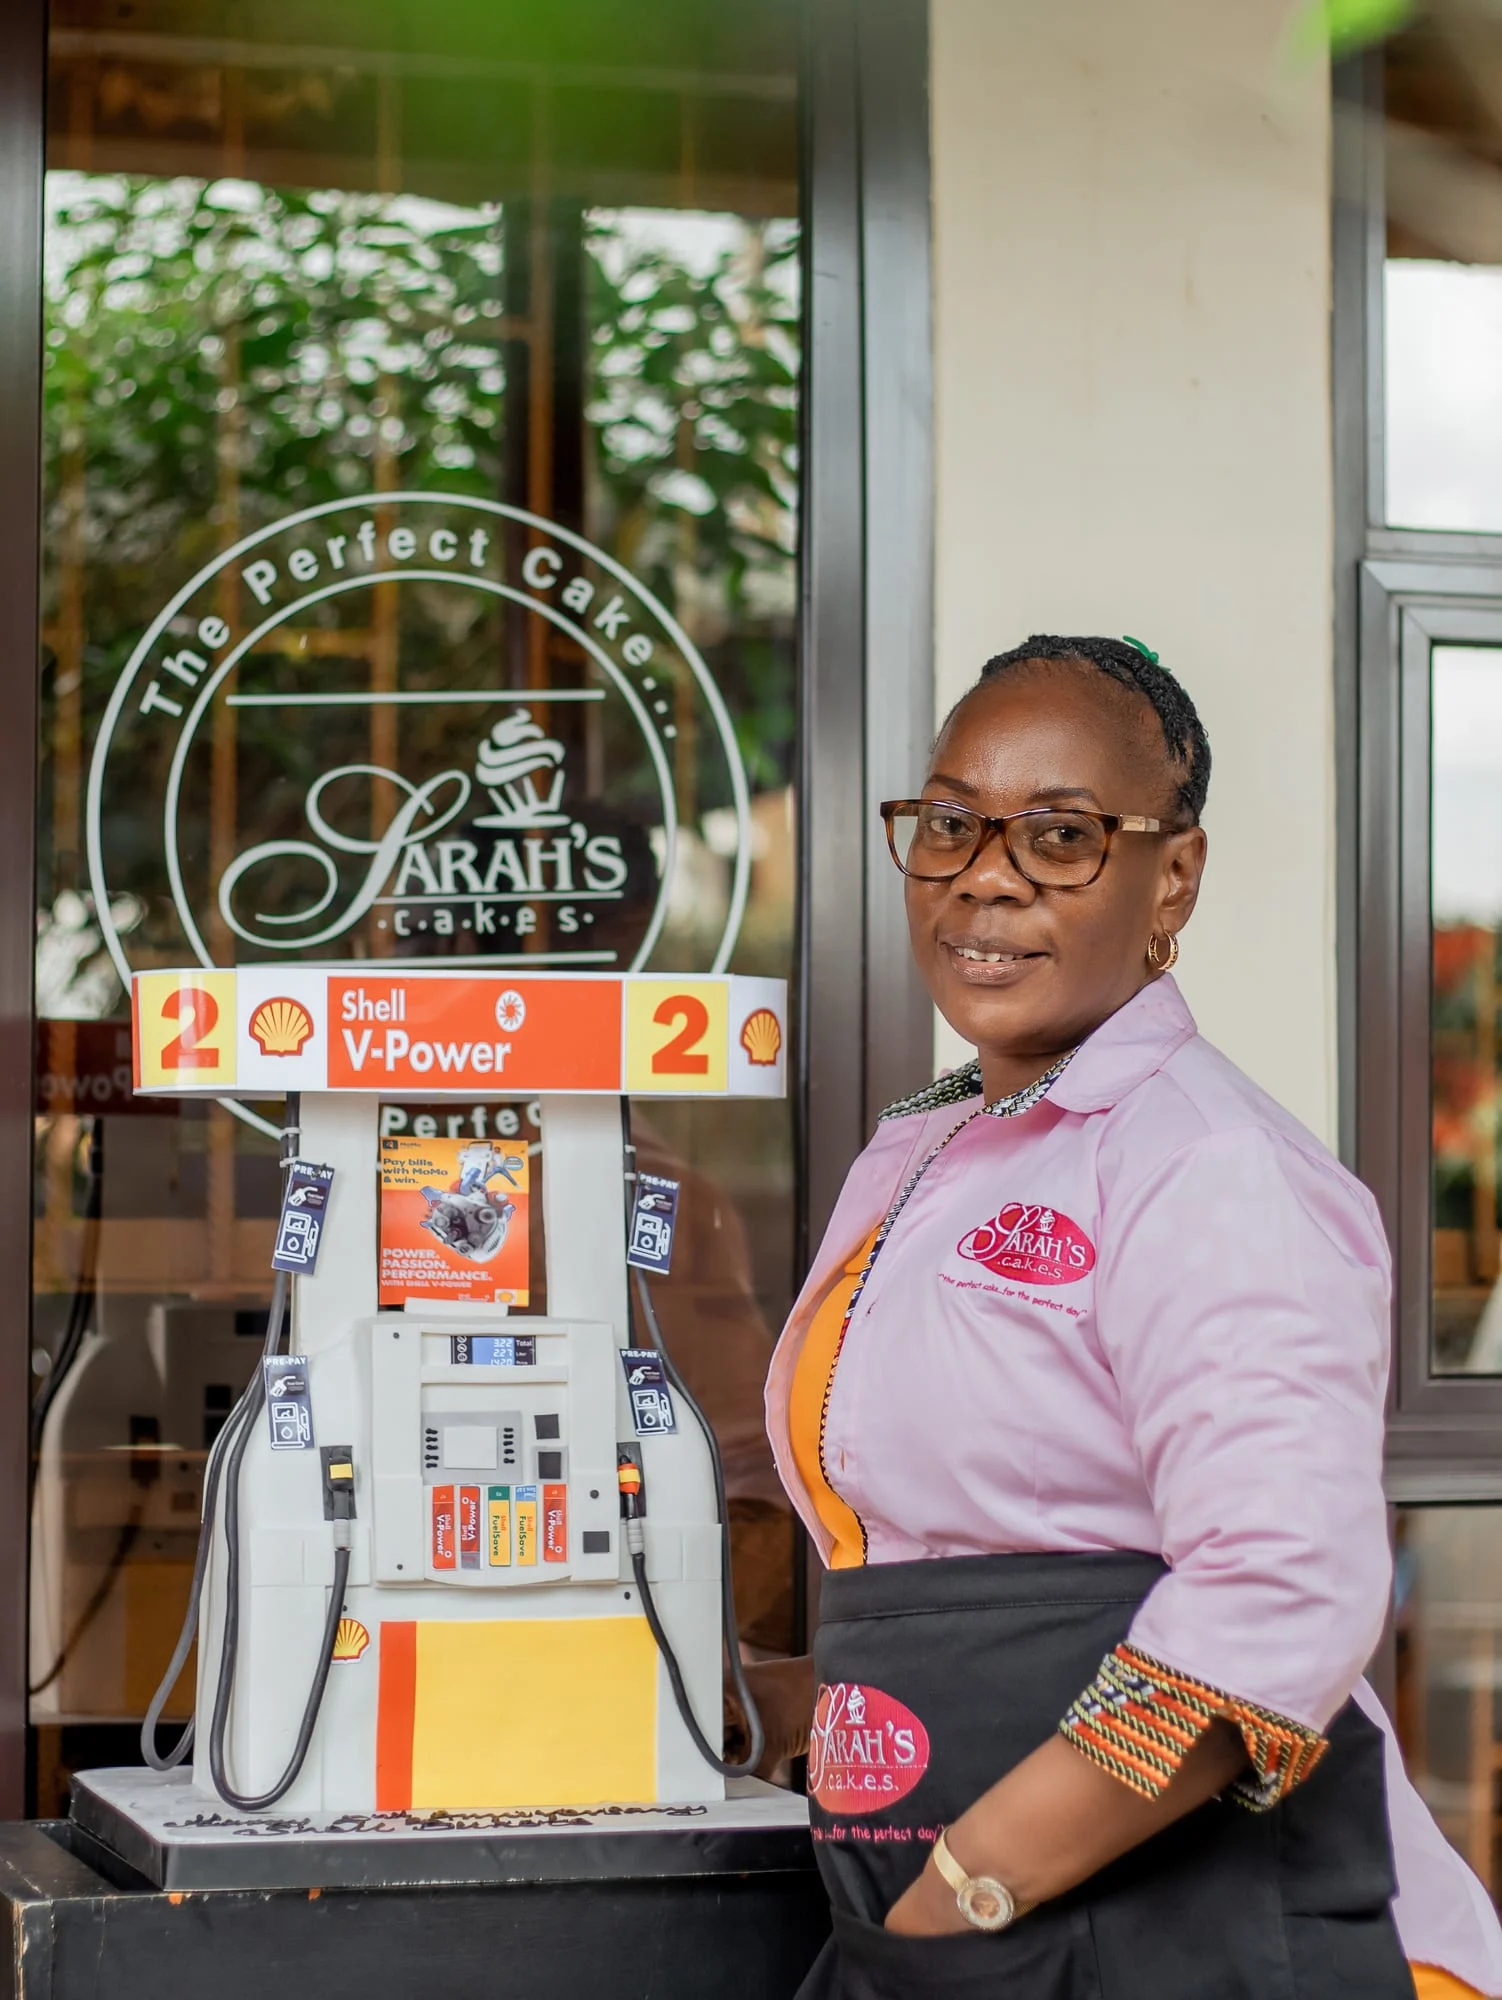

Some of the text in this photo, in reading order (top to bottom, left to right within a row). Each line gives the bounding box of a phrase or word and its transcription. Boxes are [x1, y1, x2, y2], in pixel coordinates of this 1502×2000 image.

[141, 615, 230, 719] The
[242, 522, 489, 605] Perfect
[219, 765, 628, 948] SARAH'S
[341, 988, 406, 1022] Shell
[160, 988, 220, 1070] 2
[651, 995, 710, 1074] 2
[344, 1029, 512, 1073] V-Power
[380, 1101, 541, 1138] Perfec
[294, 1163, 333, 1180] PRE-AY
[383, 1158, 433, 1167] Pay bills
[640, 1173, 679, 1190] PRE-PAY
[382, 1247, 440, 1259] POWER.
[382, 1259, 451, 1269] PASSION.
[381, 1269, 493, 1281] PERFORMANCE.
[432, 1280, 472, 1288] V-POWER
[956, 1280, 981, 1289] perfect
[1018, 1291, 1030, 1301] the
[1032, 1297, 1063, 1312] perfect
[516, 1339, 533, 1347] Total
[266, 1357, 306, 1366] PRE-PAY
[621, 1350, 658, 1359] PRE-PAY
[492, 1515, 500, 1556] FuelSave
[851, 1824, 871, 1839] the
[874, 1824, 912, 1843] perfect
